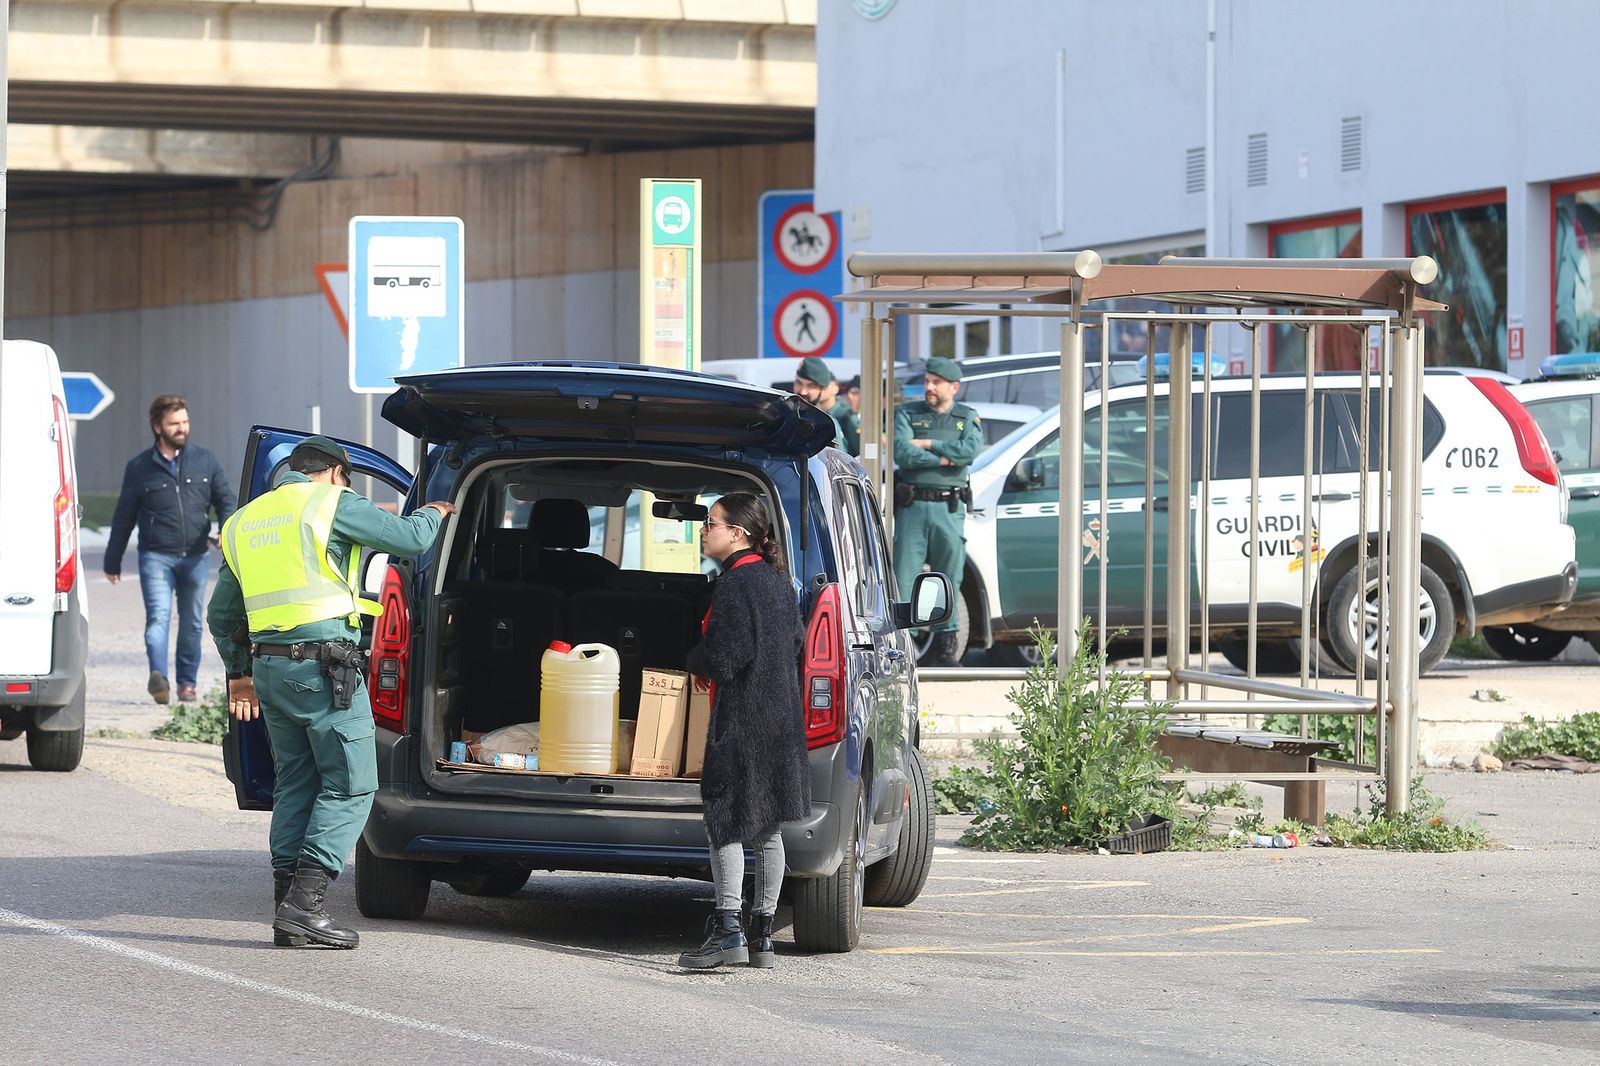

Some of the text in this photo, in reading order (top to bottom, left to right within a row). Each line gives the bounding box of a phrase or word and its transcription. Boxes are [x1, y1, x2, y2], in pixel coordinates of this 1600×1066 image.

[1461, 447, 1499, 468] 062
[241, 512, 294, 533] GUARDIA
[249, 530, 281, 549] CIVIL
[1241, 539, 1295, 558] CIVIL
